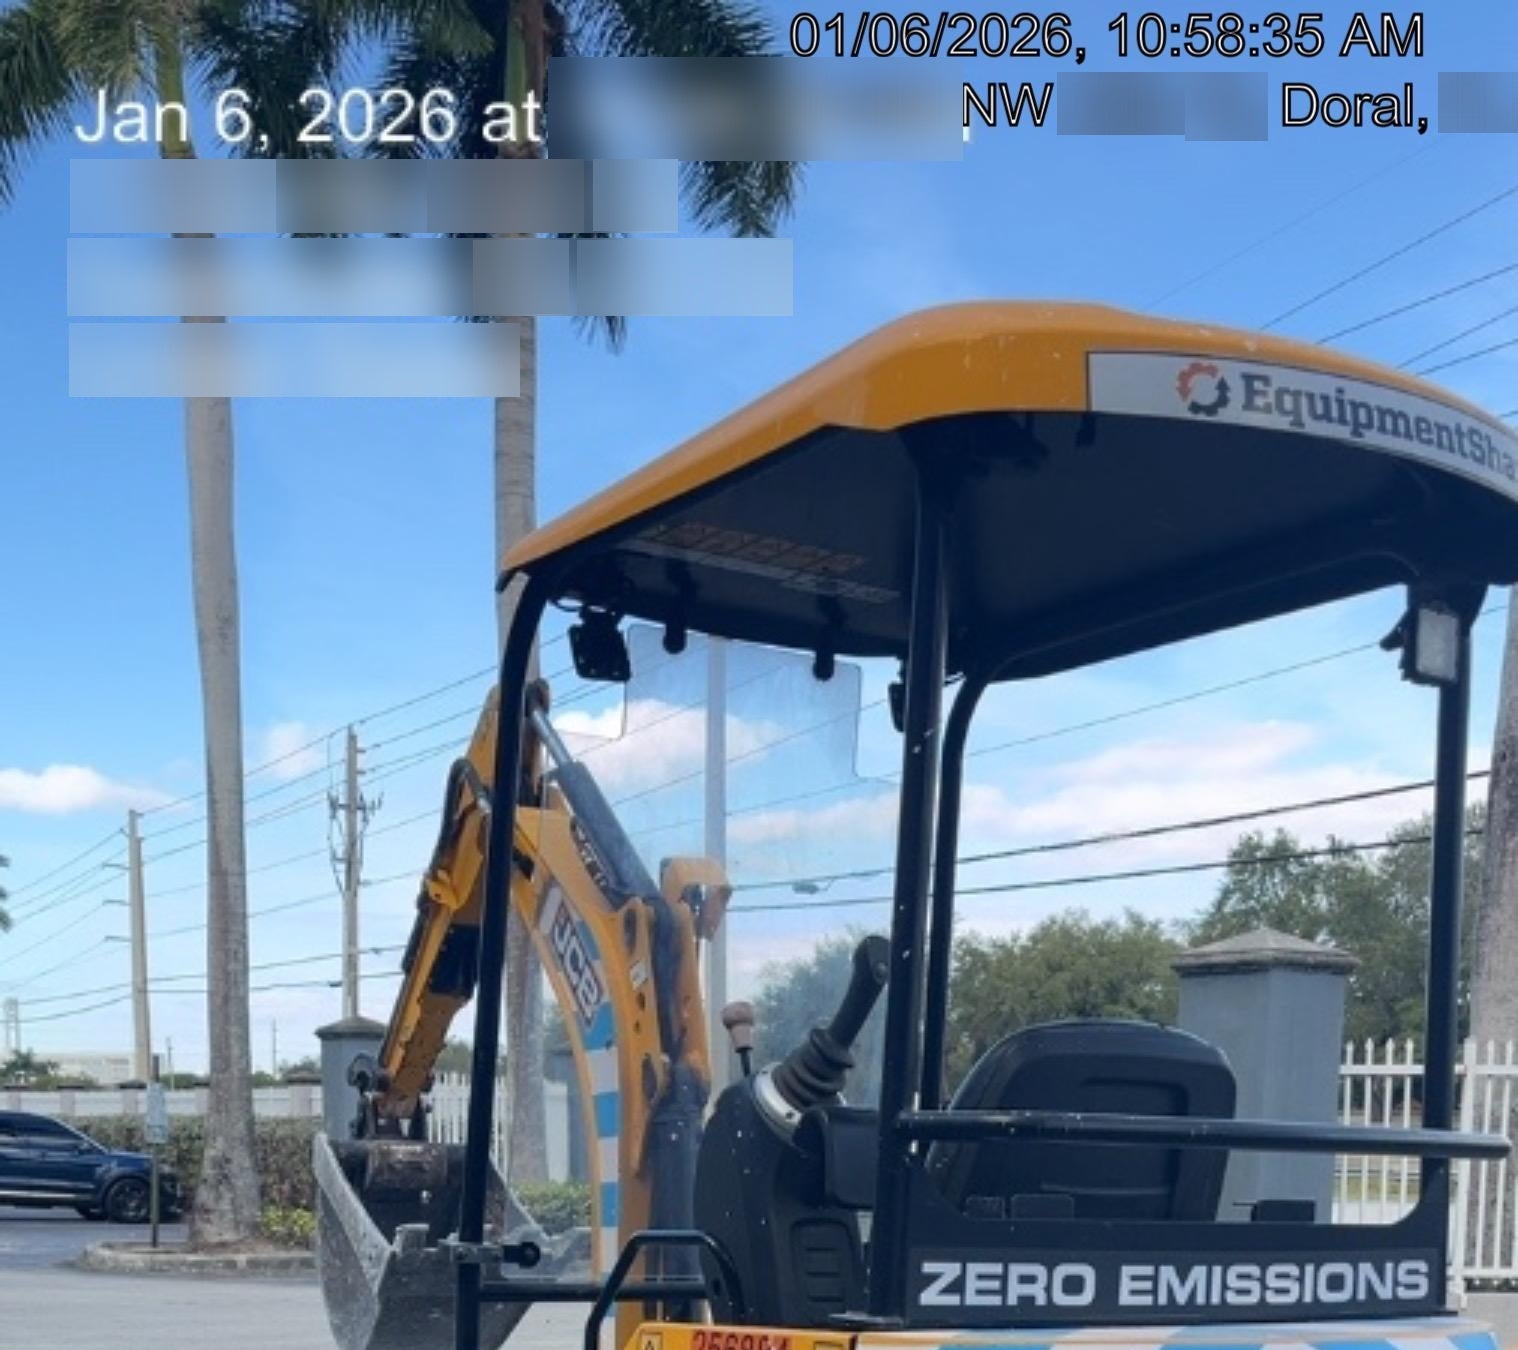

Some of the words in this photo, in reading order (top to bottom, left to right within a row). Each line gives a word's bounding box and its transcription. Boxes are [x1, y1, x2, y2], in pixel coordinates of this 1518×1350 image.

[553, 918, 602, 1020] JCB
[920, 1262, 1096, 1306] ZERO
[1118, 1260, 1429, 1306] EMISSIONS
